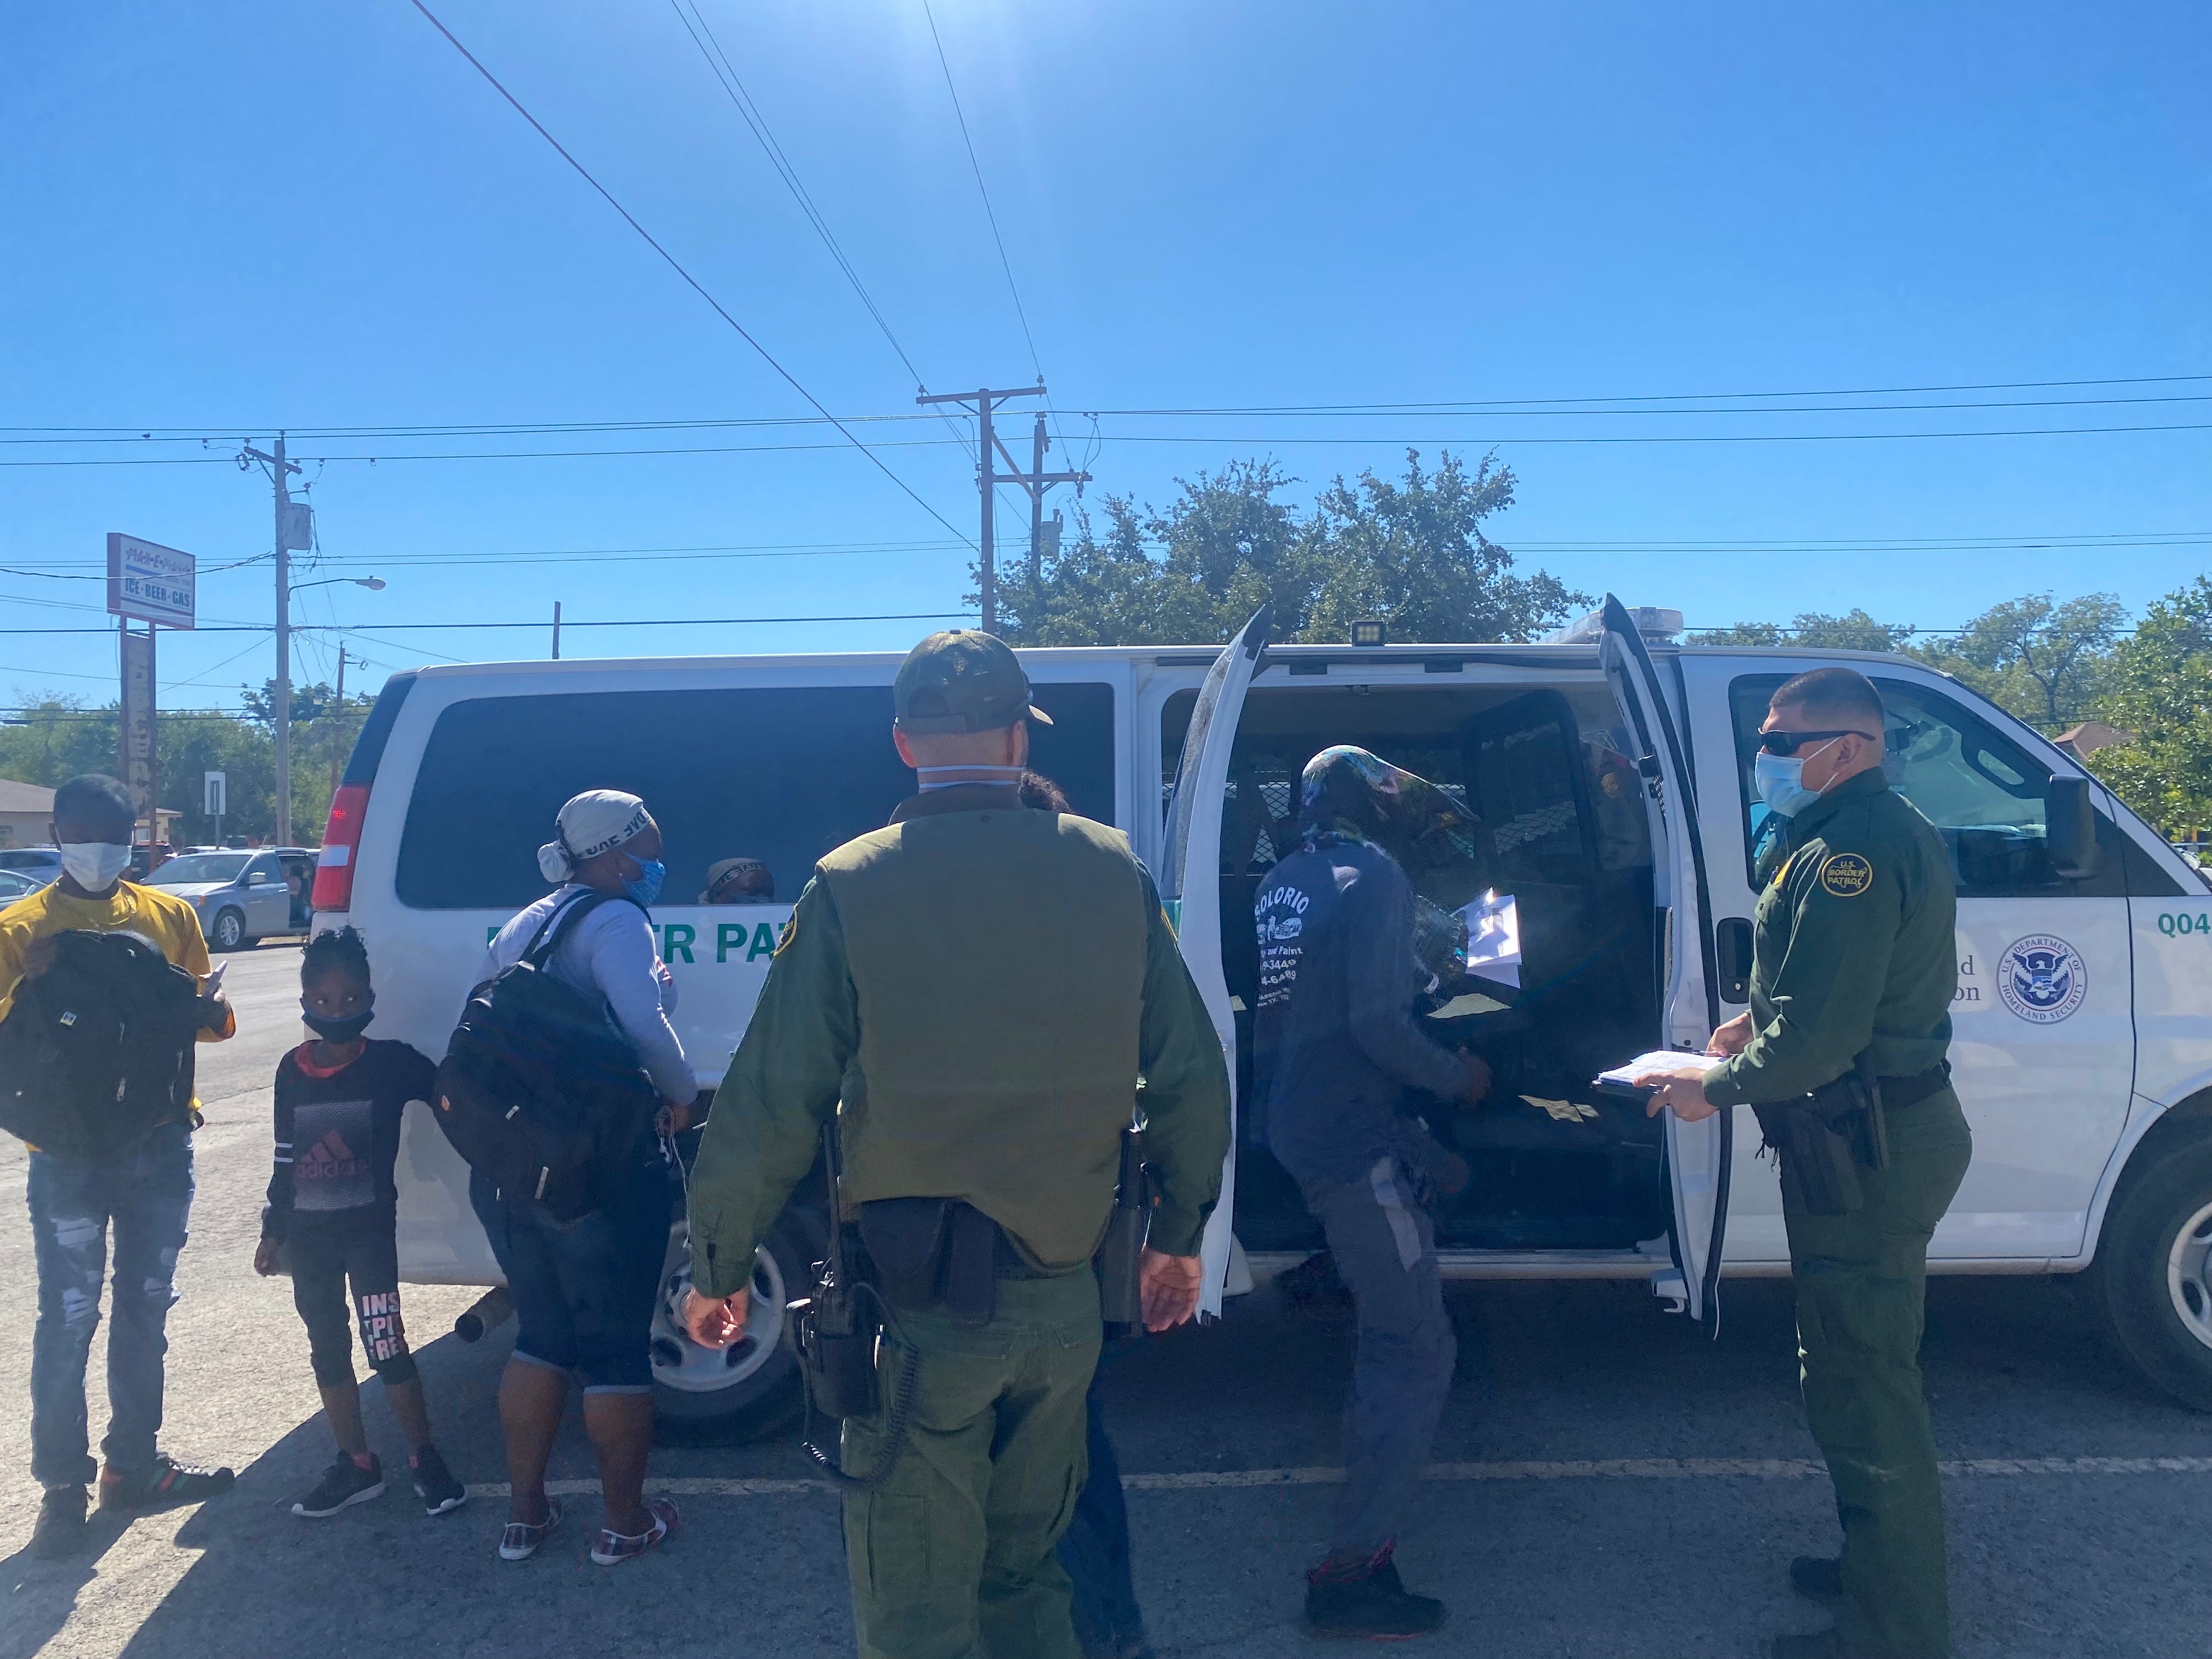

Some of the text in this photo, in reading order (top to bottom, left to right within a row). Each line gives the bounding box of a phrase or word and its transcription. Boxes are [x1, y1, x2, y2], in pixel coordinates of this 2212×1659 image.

[125, 578, 190, 607] ICE BEER GAS
[1829, 869, 1865, 877] BORDER
[2001, 938, 2083, 973] U.S. DEPARTMENT OF
[2002, 982, 2083, 1020] HOMELAND SECURITY
[295, 1159, 372, 1179] adida
